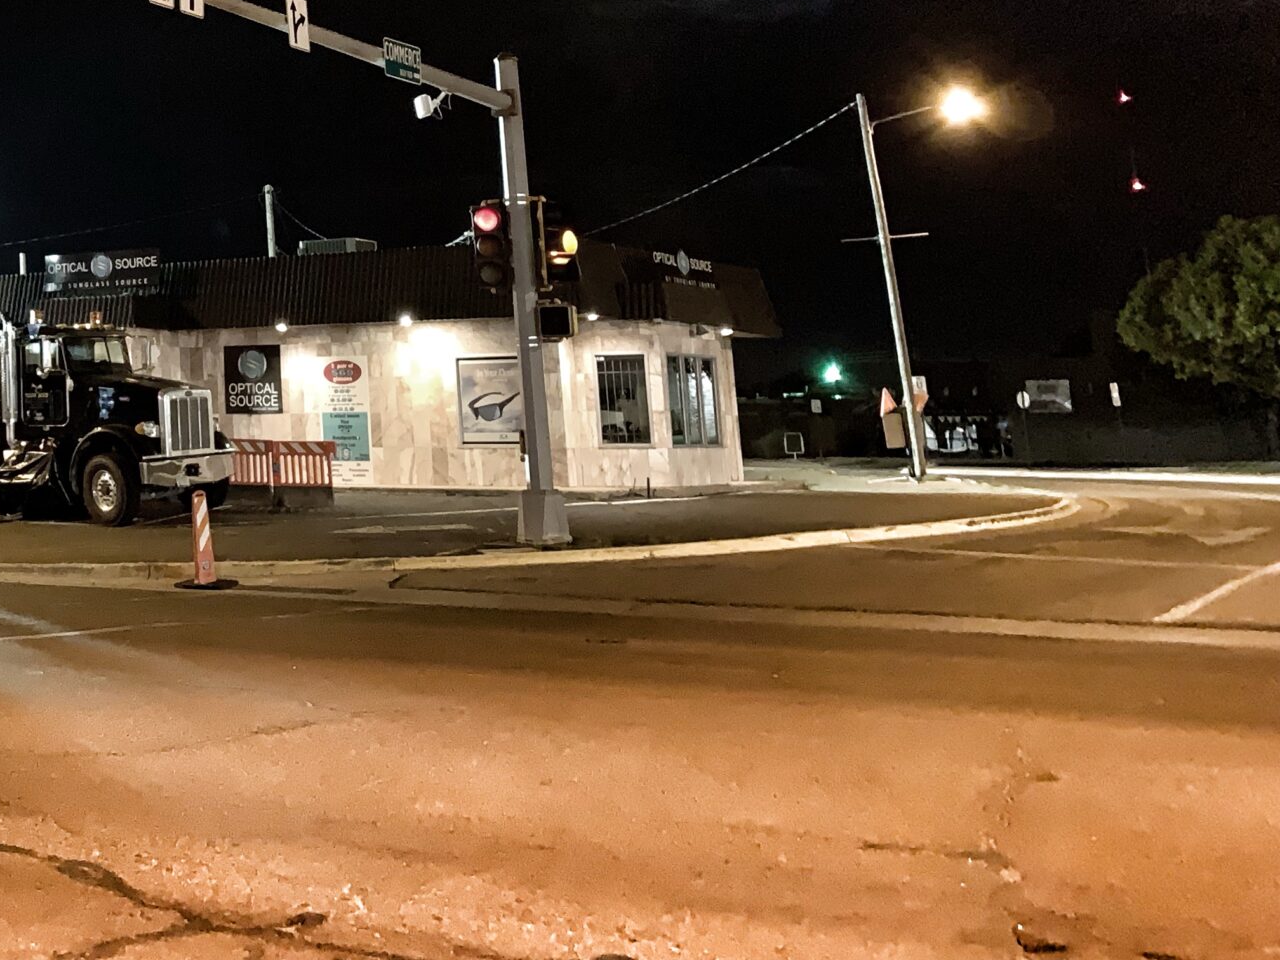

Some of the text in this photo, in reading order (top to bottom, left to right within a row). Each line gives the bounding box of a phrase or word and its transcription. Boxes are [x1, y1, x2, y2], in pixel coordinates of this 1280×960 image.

[384, 40, 421, 69] COMMERCE
[47, 255, 158, 275] OPTICAL SOURCE
[652, 251, 713, 273] OPTICAL SOURCE
[115, 278, 148, 287] SOURCE
[228, 382, 279, 394] OPTICAL
[229, 394, 279, 407] SOURCE
